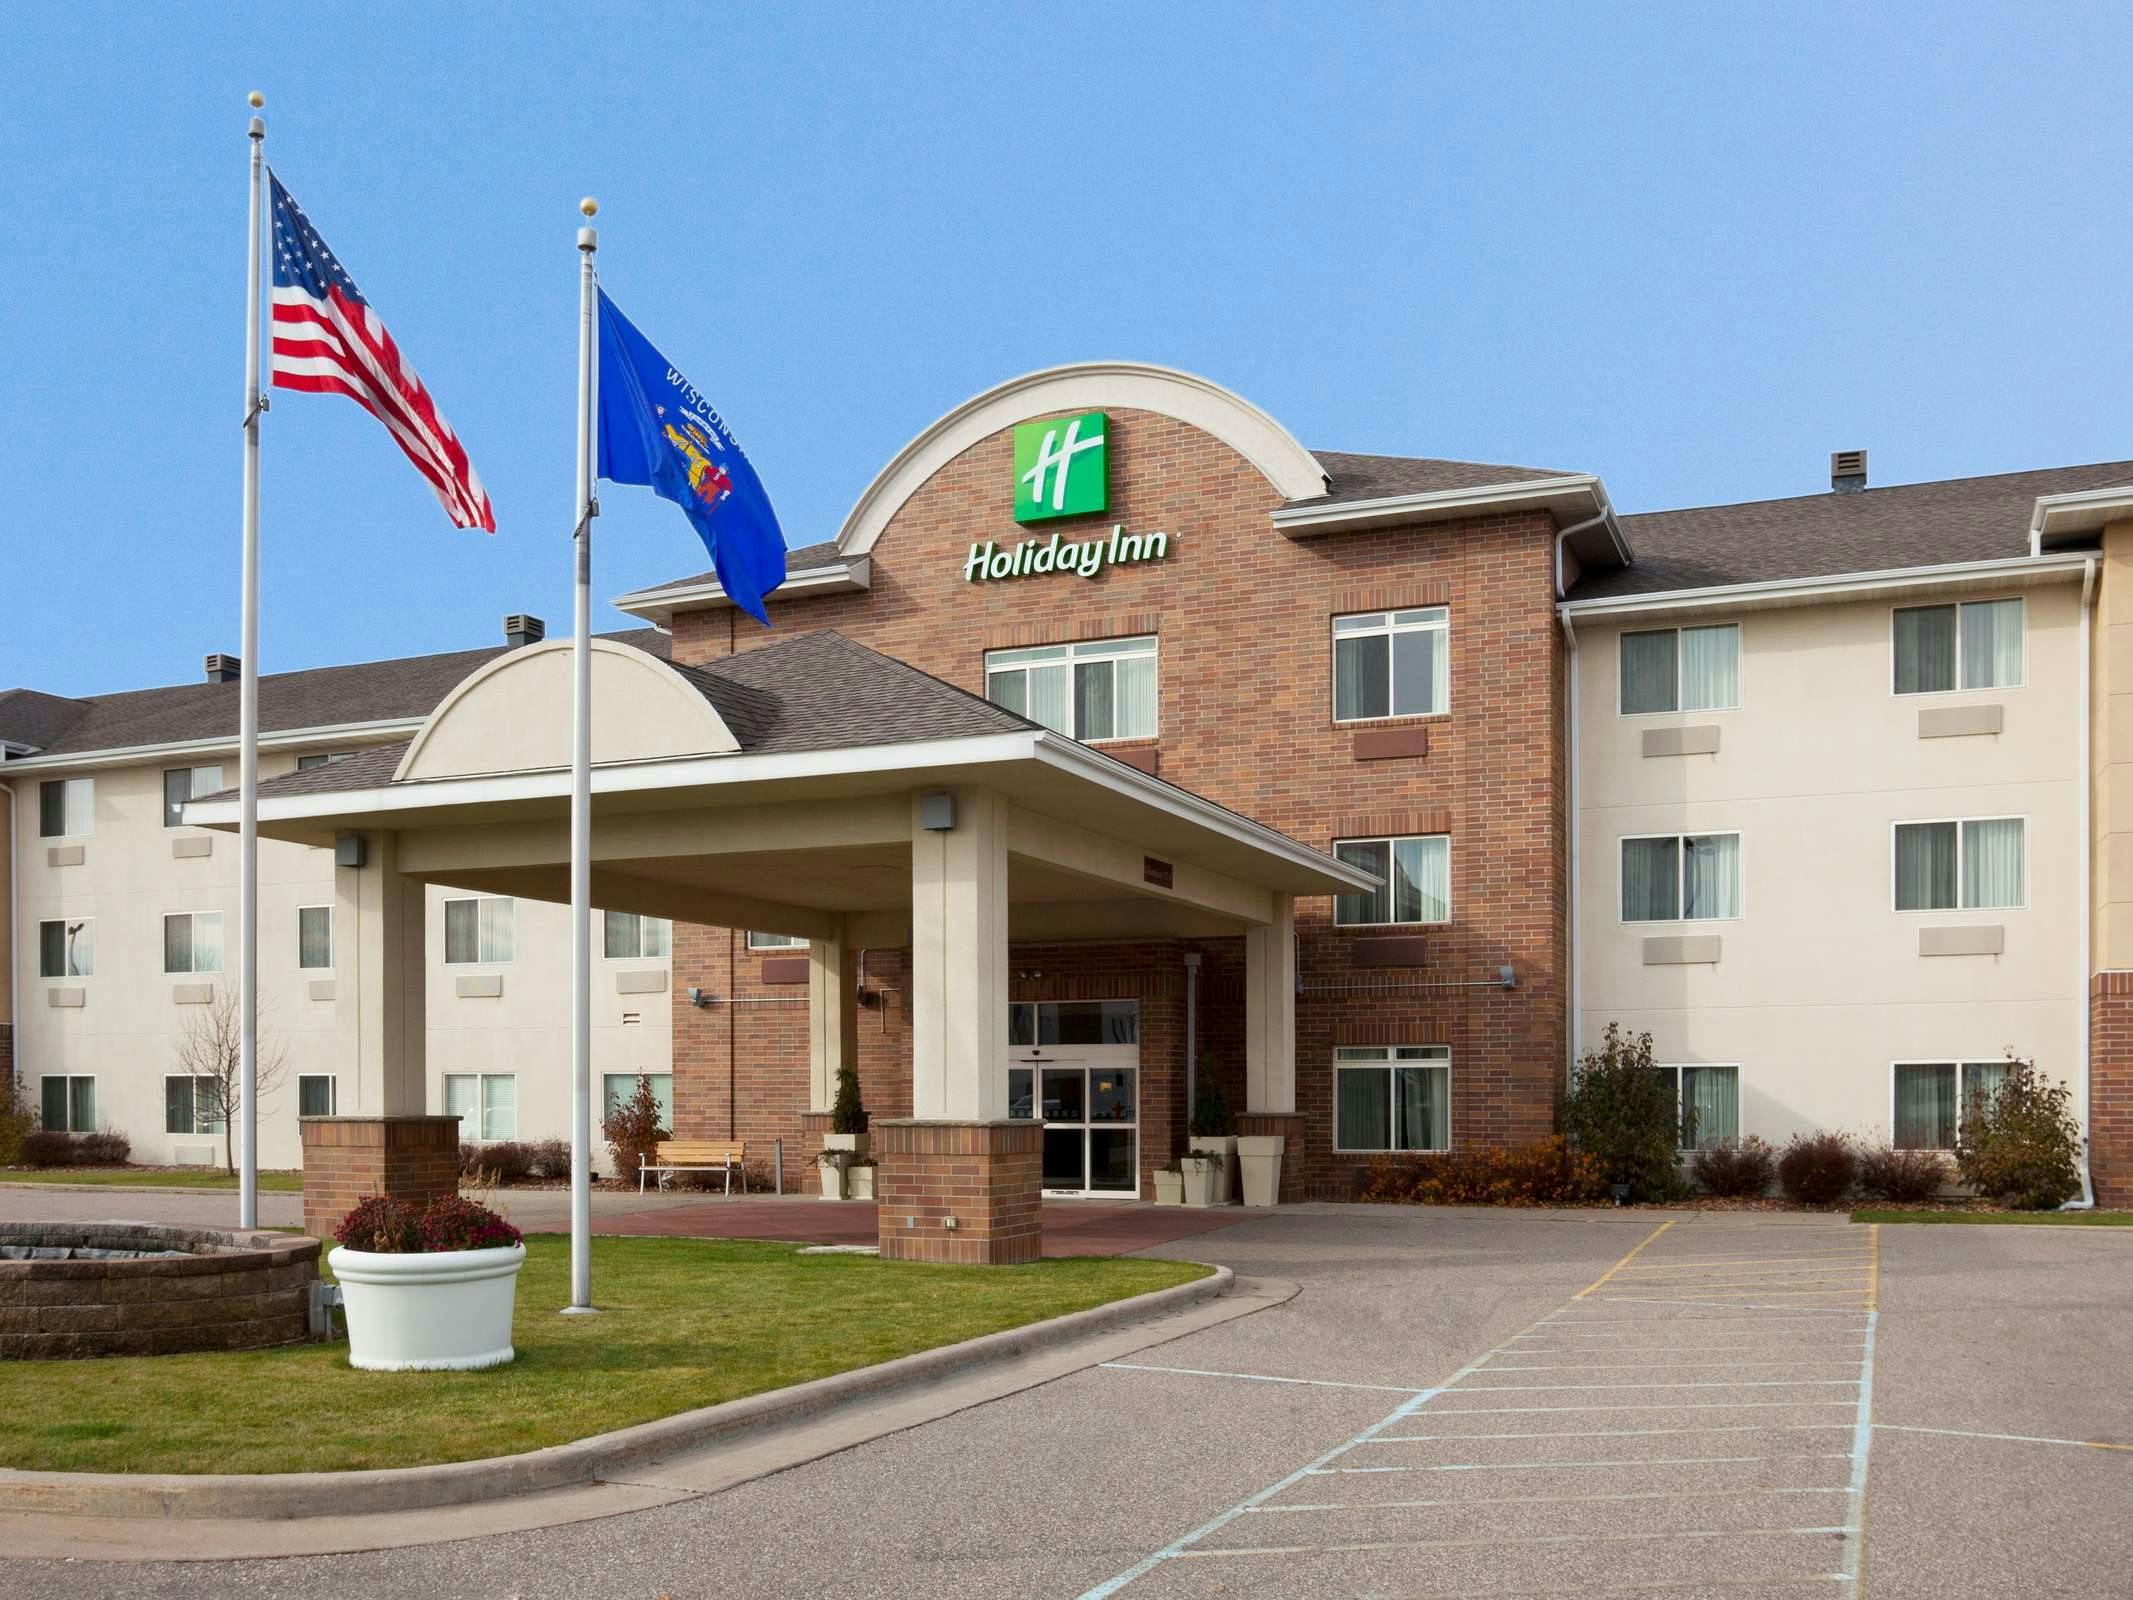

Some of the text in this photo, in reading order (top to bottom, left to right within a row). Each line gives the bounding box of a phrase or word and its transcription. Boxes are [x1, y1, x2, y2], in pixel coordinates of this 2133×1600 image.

[667, 367, 749, 459] WISCON
[963, 524, 1168, 582] Holiday Inn
